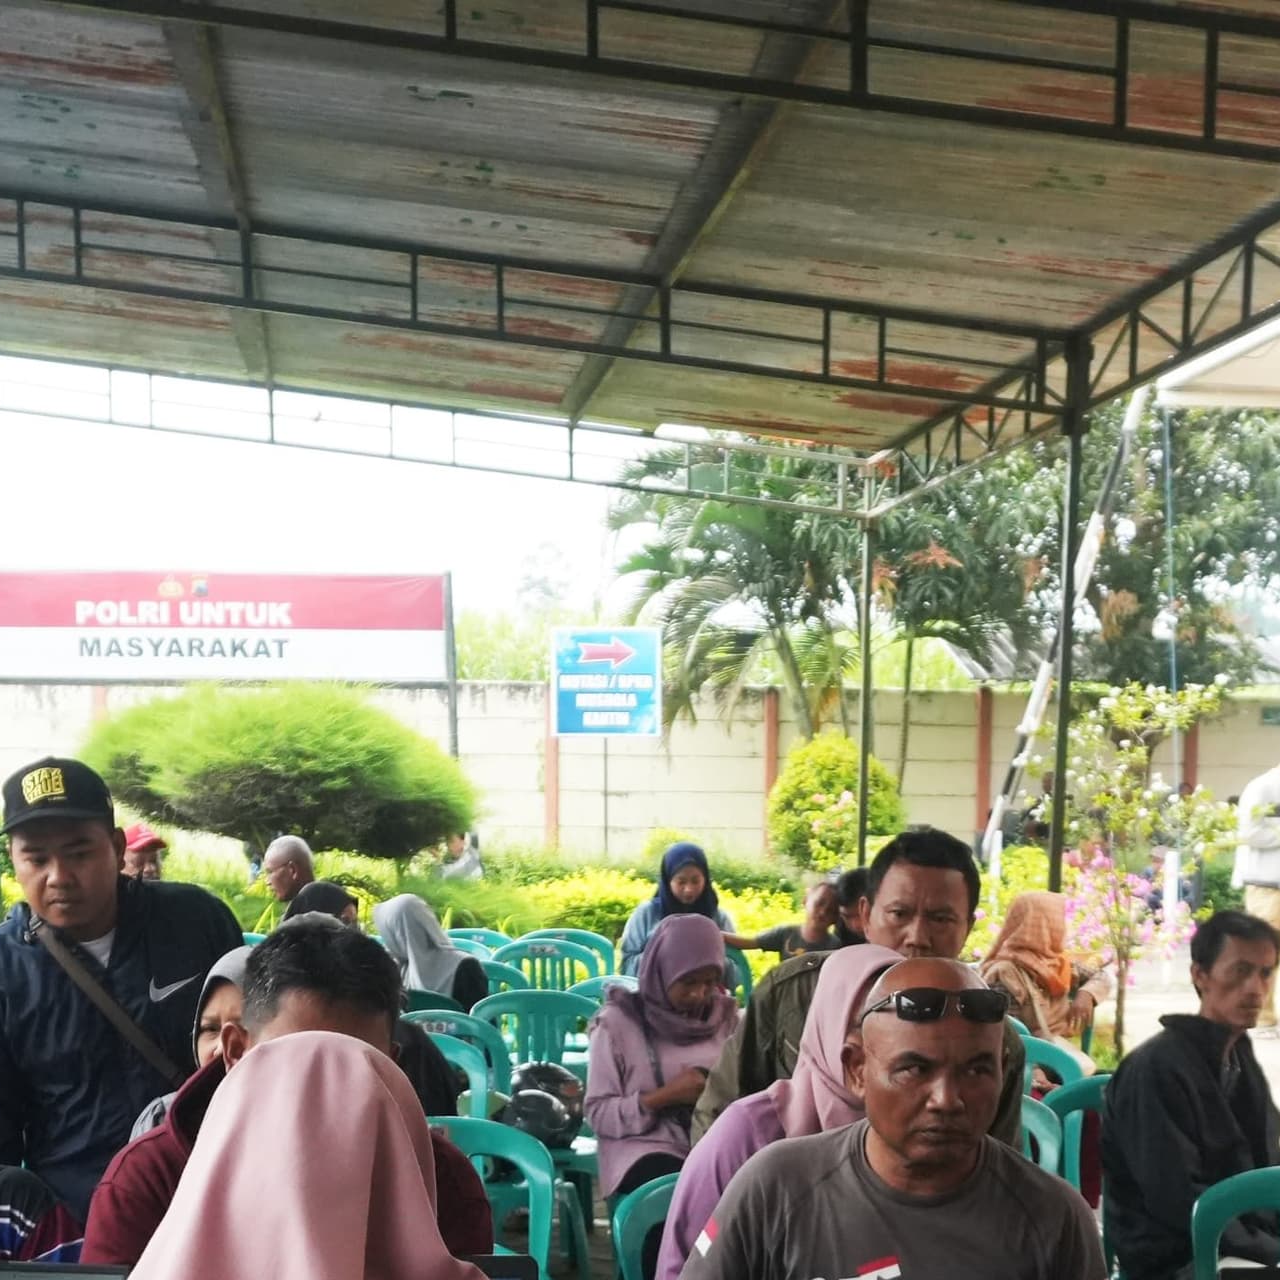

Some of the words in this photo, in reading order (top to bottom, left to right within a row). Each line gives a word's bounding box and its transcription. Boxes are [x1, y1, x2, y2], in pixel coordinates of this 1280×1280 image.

[74, 600, 169, 625] POLRI
[179, 601, 293, 626] UNTUK
[78, 637, 289, 658] MASYARAKAT
